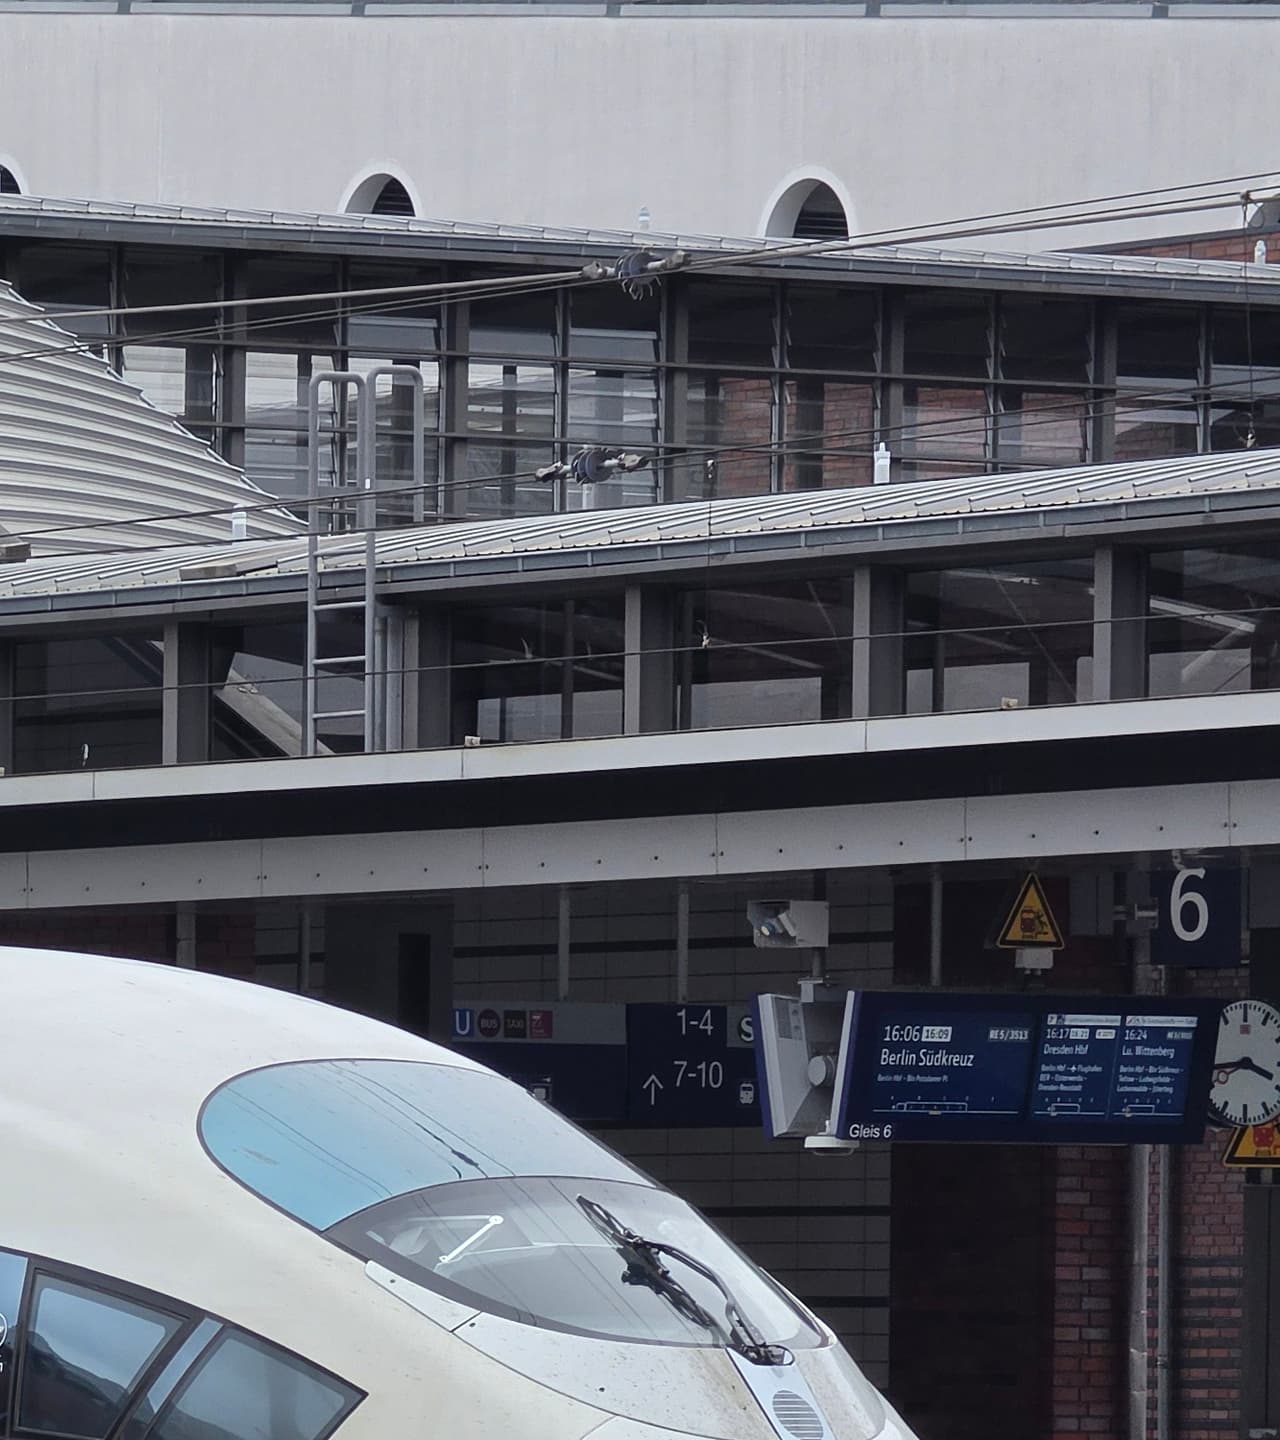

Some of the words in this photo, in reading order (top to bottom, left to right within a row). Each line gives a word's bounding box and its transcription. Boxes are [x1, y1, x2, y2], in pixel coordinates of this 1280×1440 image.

[1170, 868, 1209, 941] 6
[455, 1010, 471, 1035] U
[676, 1008, 714, 1035] 1-4
[883, 1025, 921, 1042] 16:06
[880, 1048, 916, 1065] Berlin
[918, 1048, 975, 1067] Südkreuz
[673, 1060, 724, 1088] 7-10
[848, 1124, 881, 1139] Gleis
[883, 1124, 893, 1139] 6
